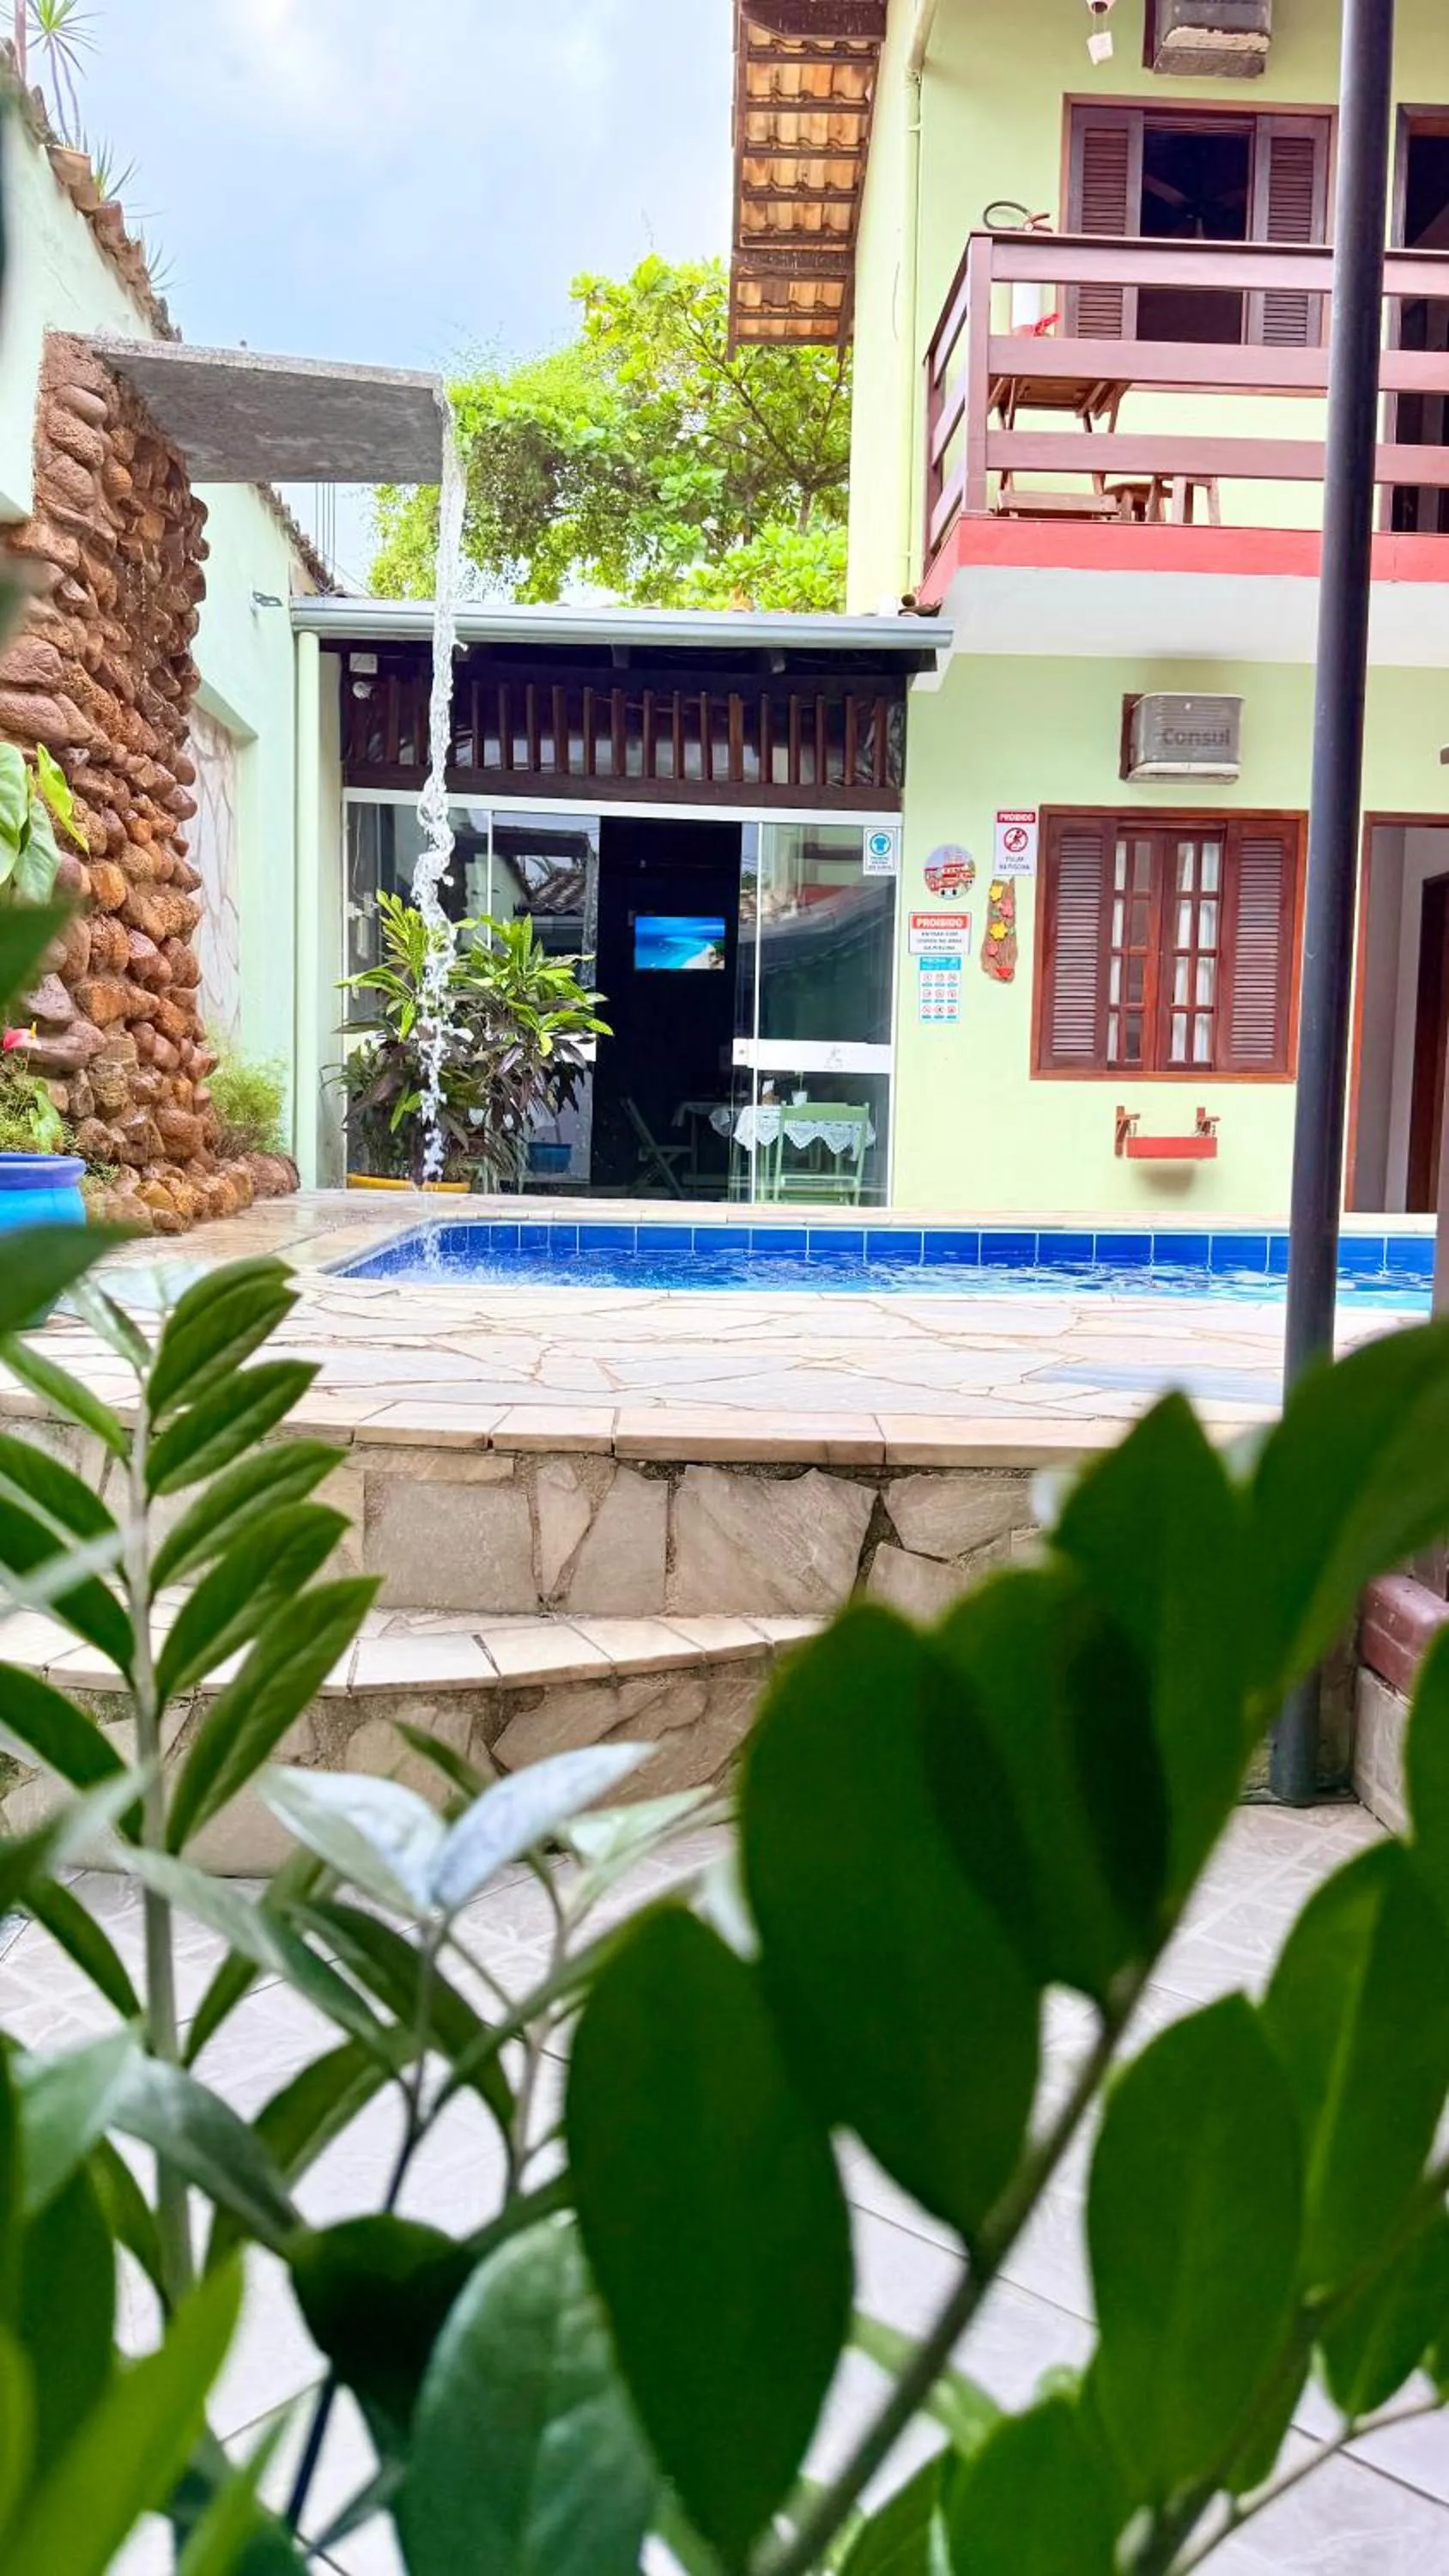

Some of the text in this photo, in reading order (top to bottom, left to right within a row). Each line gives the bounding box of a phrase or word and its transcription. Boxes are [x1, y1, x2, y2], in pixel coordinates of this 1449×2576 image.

[1161, 727, 1230, 746] Consul
[999, 813, 1034, 822] PROIBIDO
[916, 918, 963, 927] PROIBIDO
